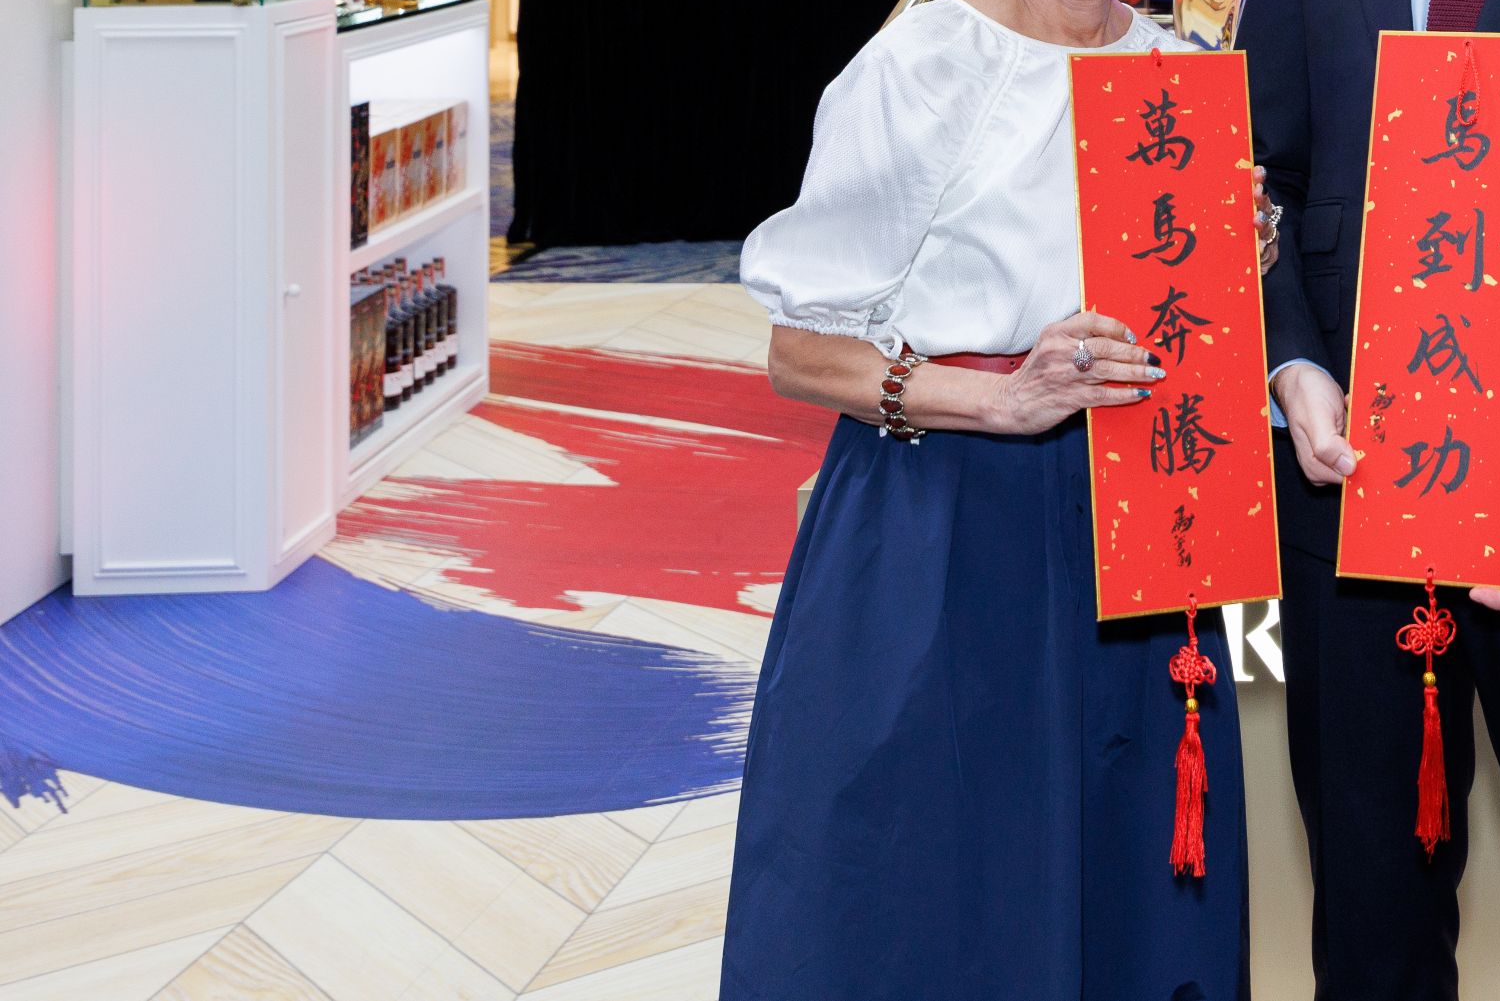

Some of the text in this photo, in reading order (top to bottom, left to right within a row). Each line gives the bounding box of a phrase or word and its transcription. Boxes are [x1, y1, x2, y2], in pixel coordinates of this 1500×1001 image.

[1126, 88, 1234, 477] 萬馬奔騰
[1393, 89, 1492, 498] 馬到成功
